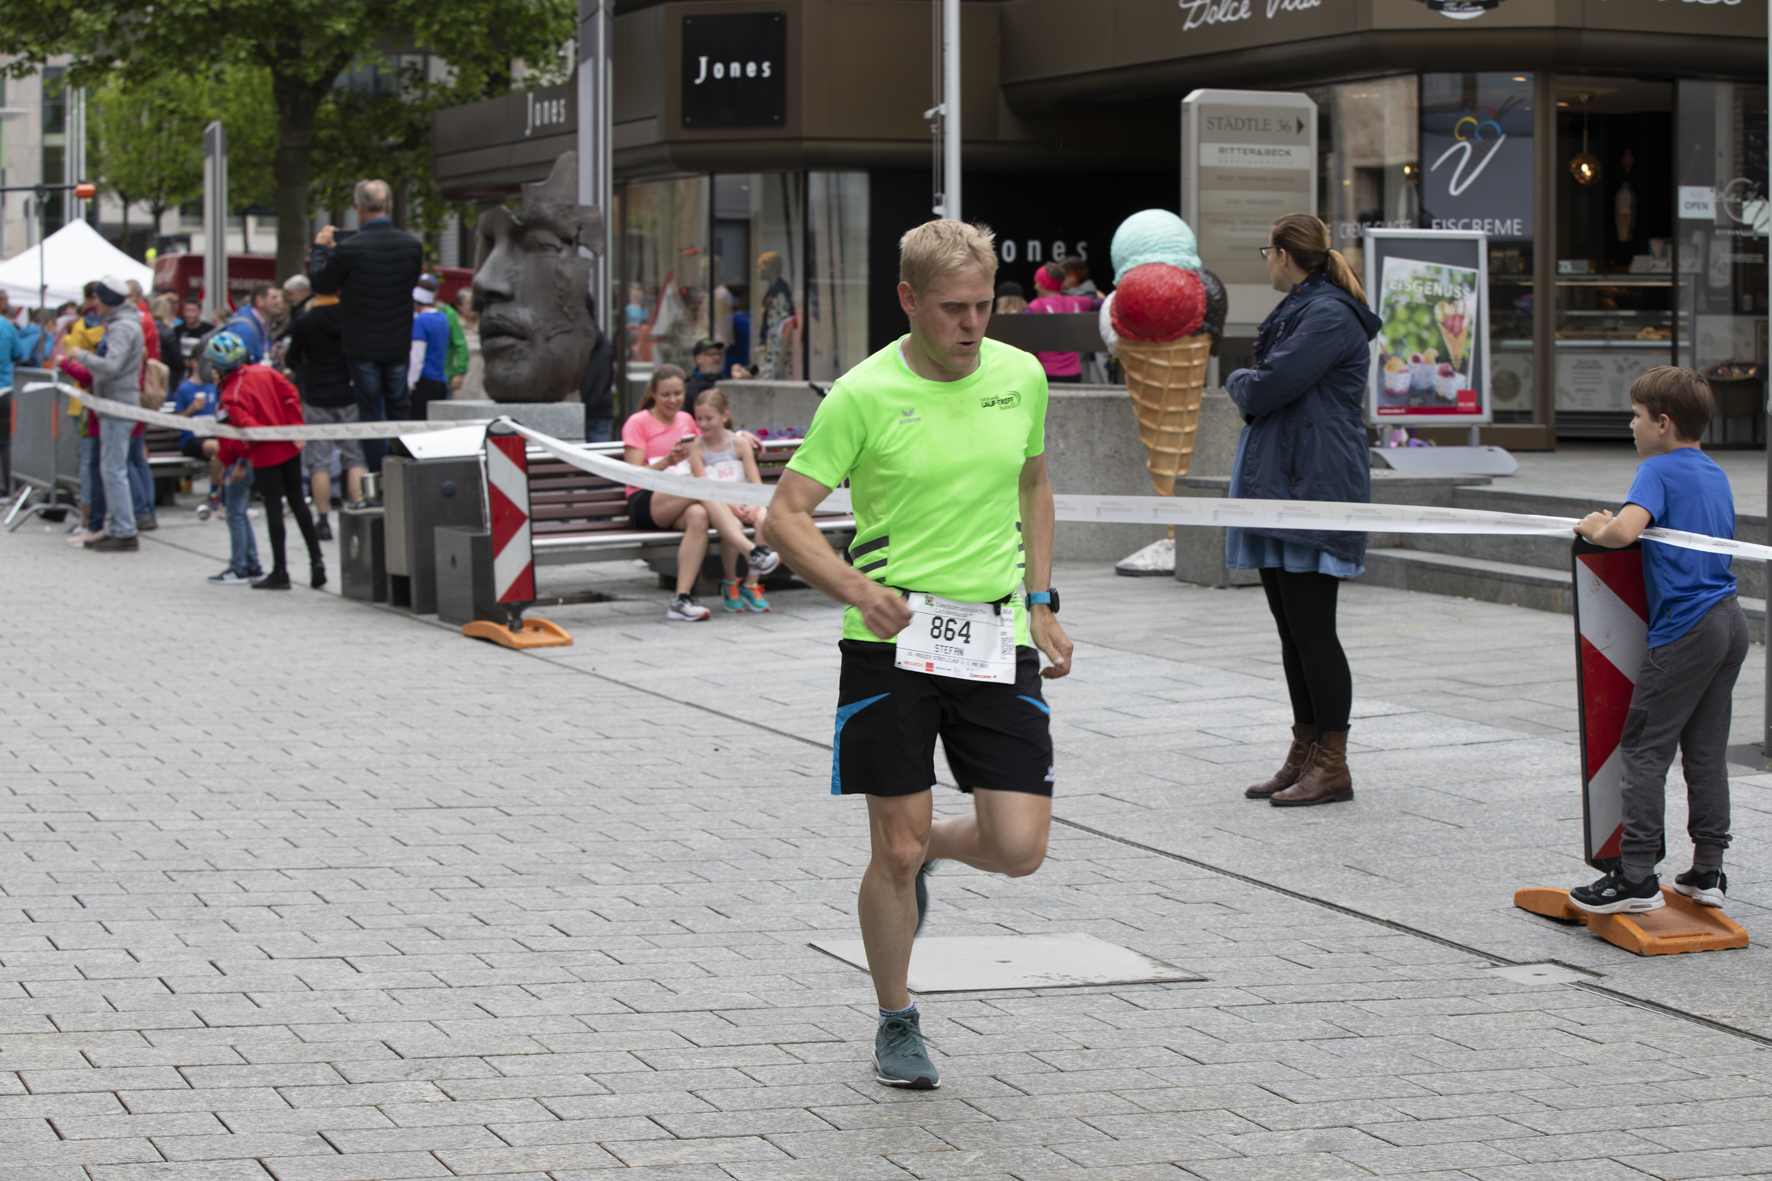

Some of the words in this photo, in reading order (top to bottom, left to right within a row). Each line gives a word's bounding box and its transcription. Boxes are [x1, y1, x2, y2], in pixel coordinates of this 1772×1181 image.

[694, 55, 772, 85] Jones
[524, 92, 566, 137] Jones
[1206, 114, 1272, 133] STÄDTLE
[1276, 119, 1292, 133] 36
[1218, 146, 1292, 157] RITTER&BECK
[1684, 201, 1709, 211] OPEN
[1001, 239, 1088, 263] ones
[930, 615, 971, 644] 864
[934, 643, 964, 656] STEFAN
